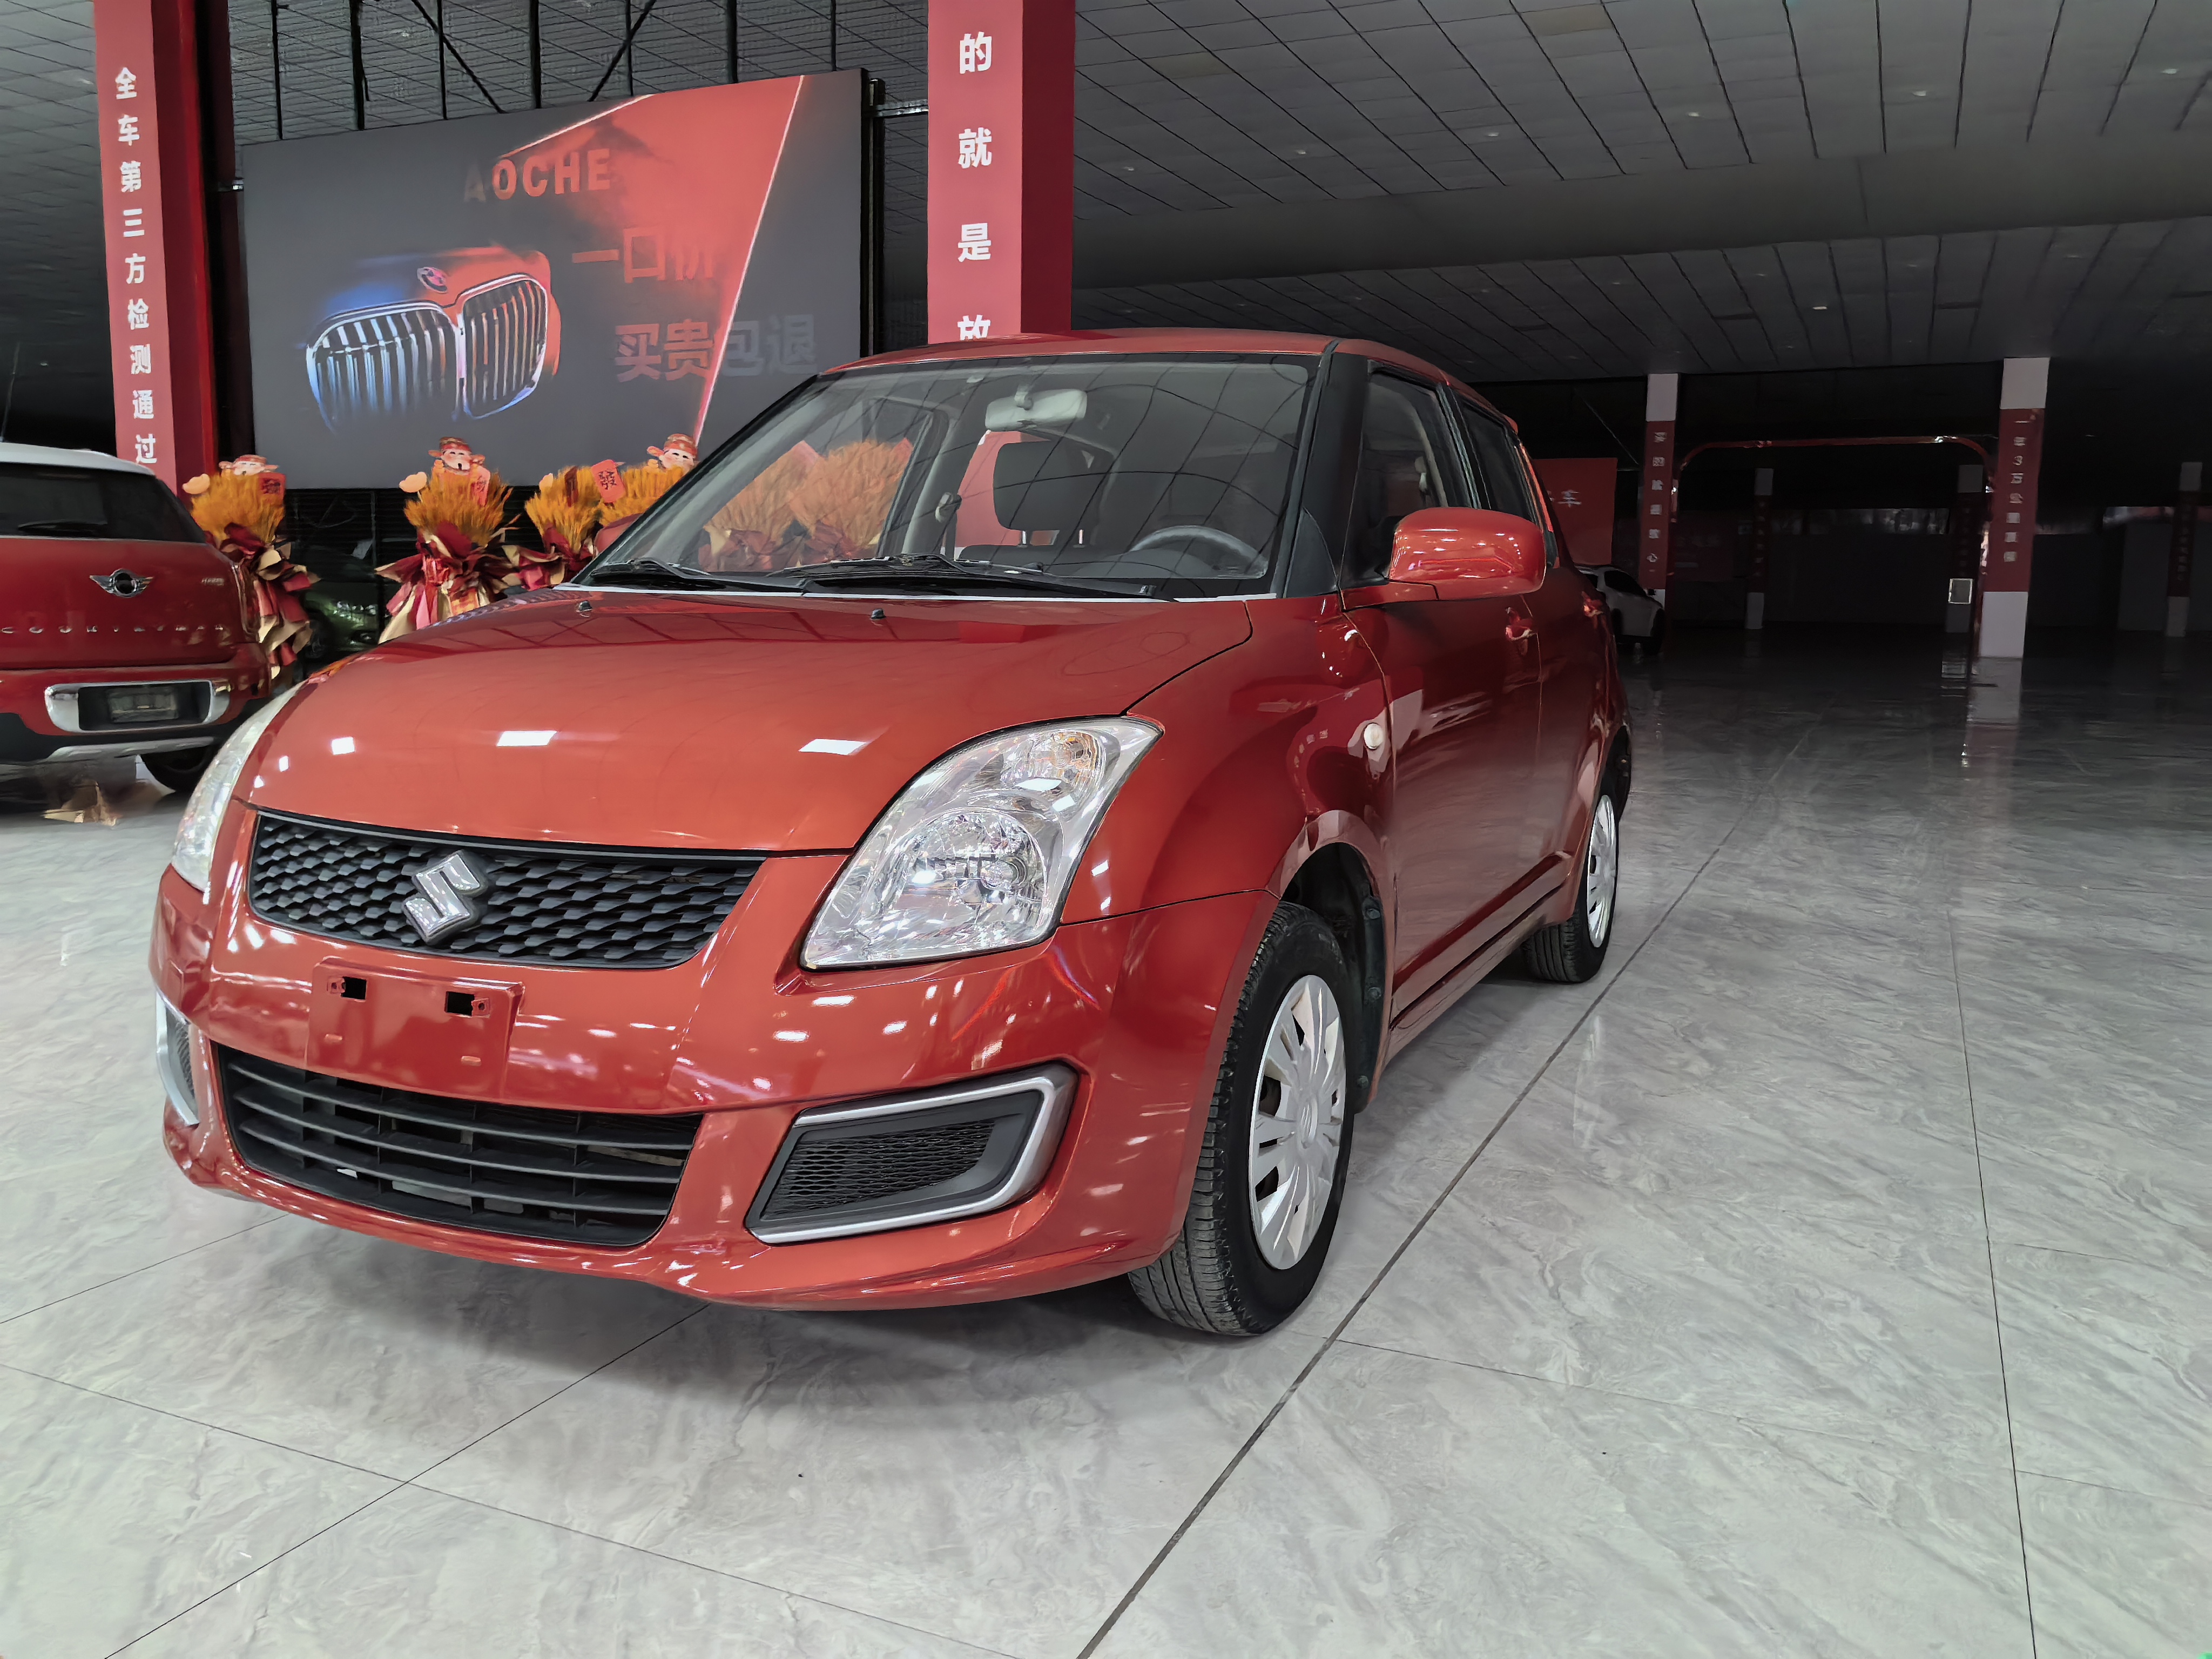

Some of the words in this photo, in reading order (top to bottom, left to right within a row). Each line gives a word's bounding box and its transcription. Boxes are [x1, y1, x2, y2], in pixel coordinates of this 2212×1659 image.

[114, 67, 157, 464] 全车第三方检测通过
[615, 314, 818, 383] 买贵包退
